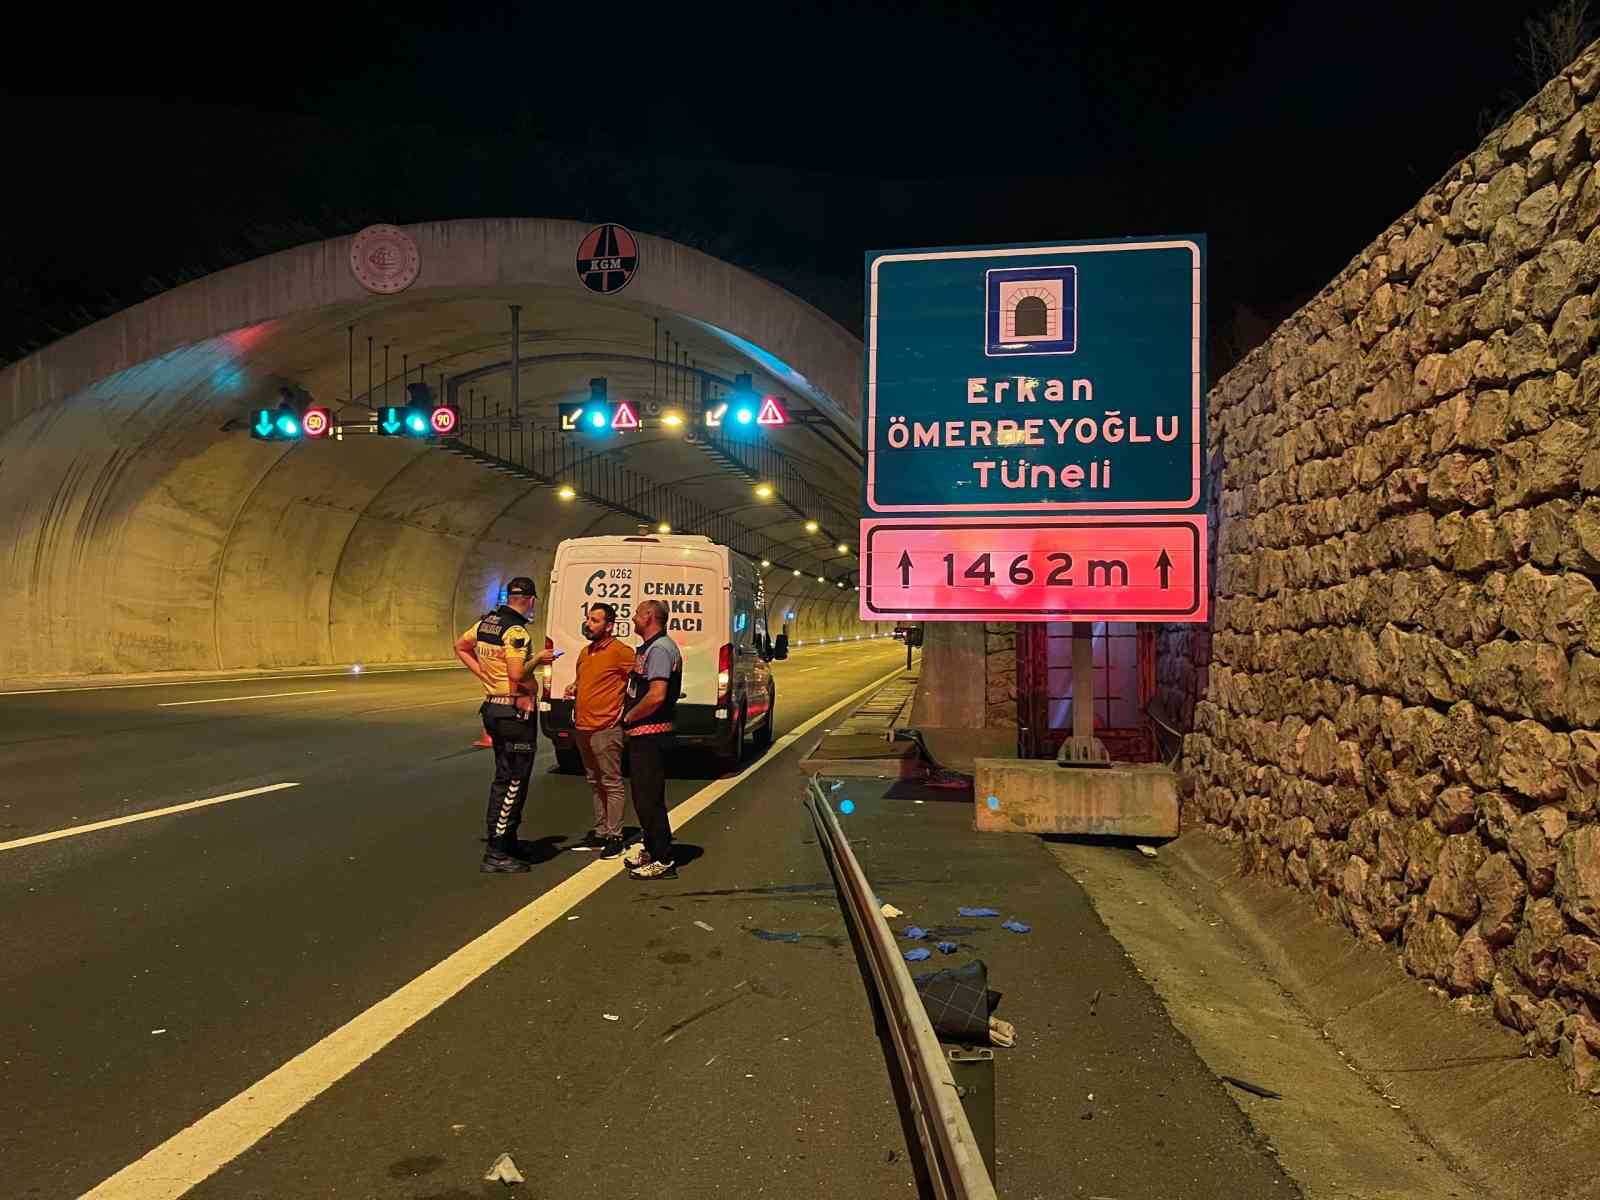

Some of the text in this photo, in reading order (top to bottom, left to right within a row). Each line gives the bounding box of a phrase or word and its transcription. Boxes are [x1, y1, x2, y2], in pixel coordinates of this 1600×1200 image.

[590, 258, 622, 270] KGM
[967, 376, 1093, 404] Erkan
[437, 414, 450, 427] 90
[887, 410, 1179, 448] ÖMERBEYOĞLU
[972, 459, 1112, 489] Tüneli
[609, 568, 632, 579] 0262
[943, 552, 1129, 587] 1462 m
[597, 583, 632, 598] 322
[643, 582, 704, 596] CENAZE
[669, 618, 702, 631] ACI
